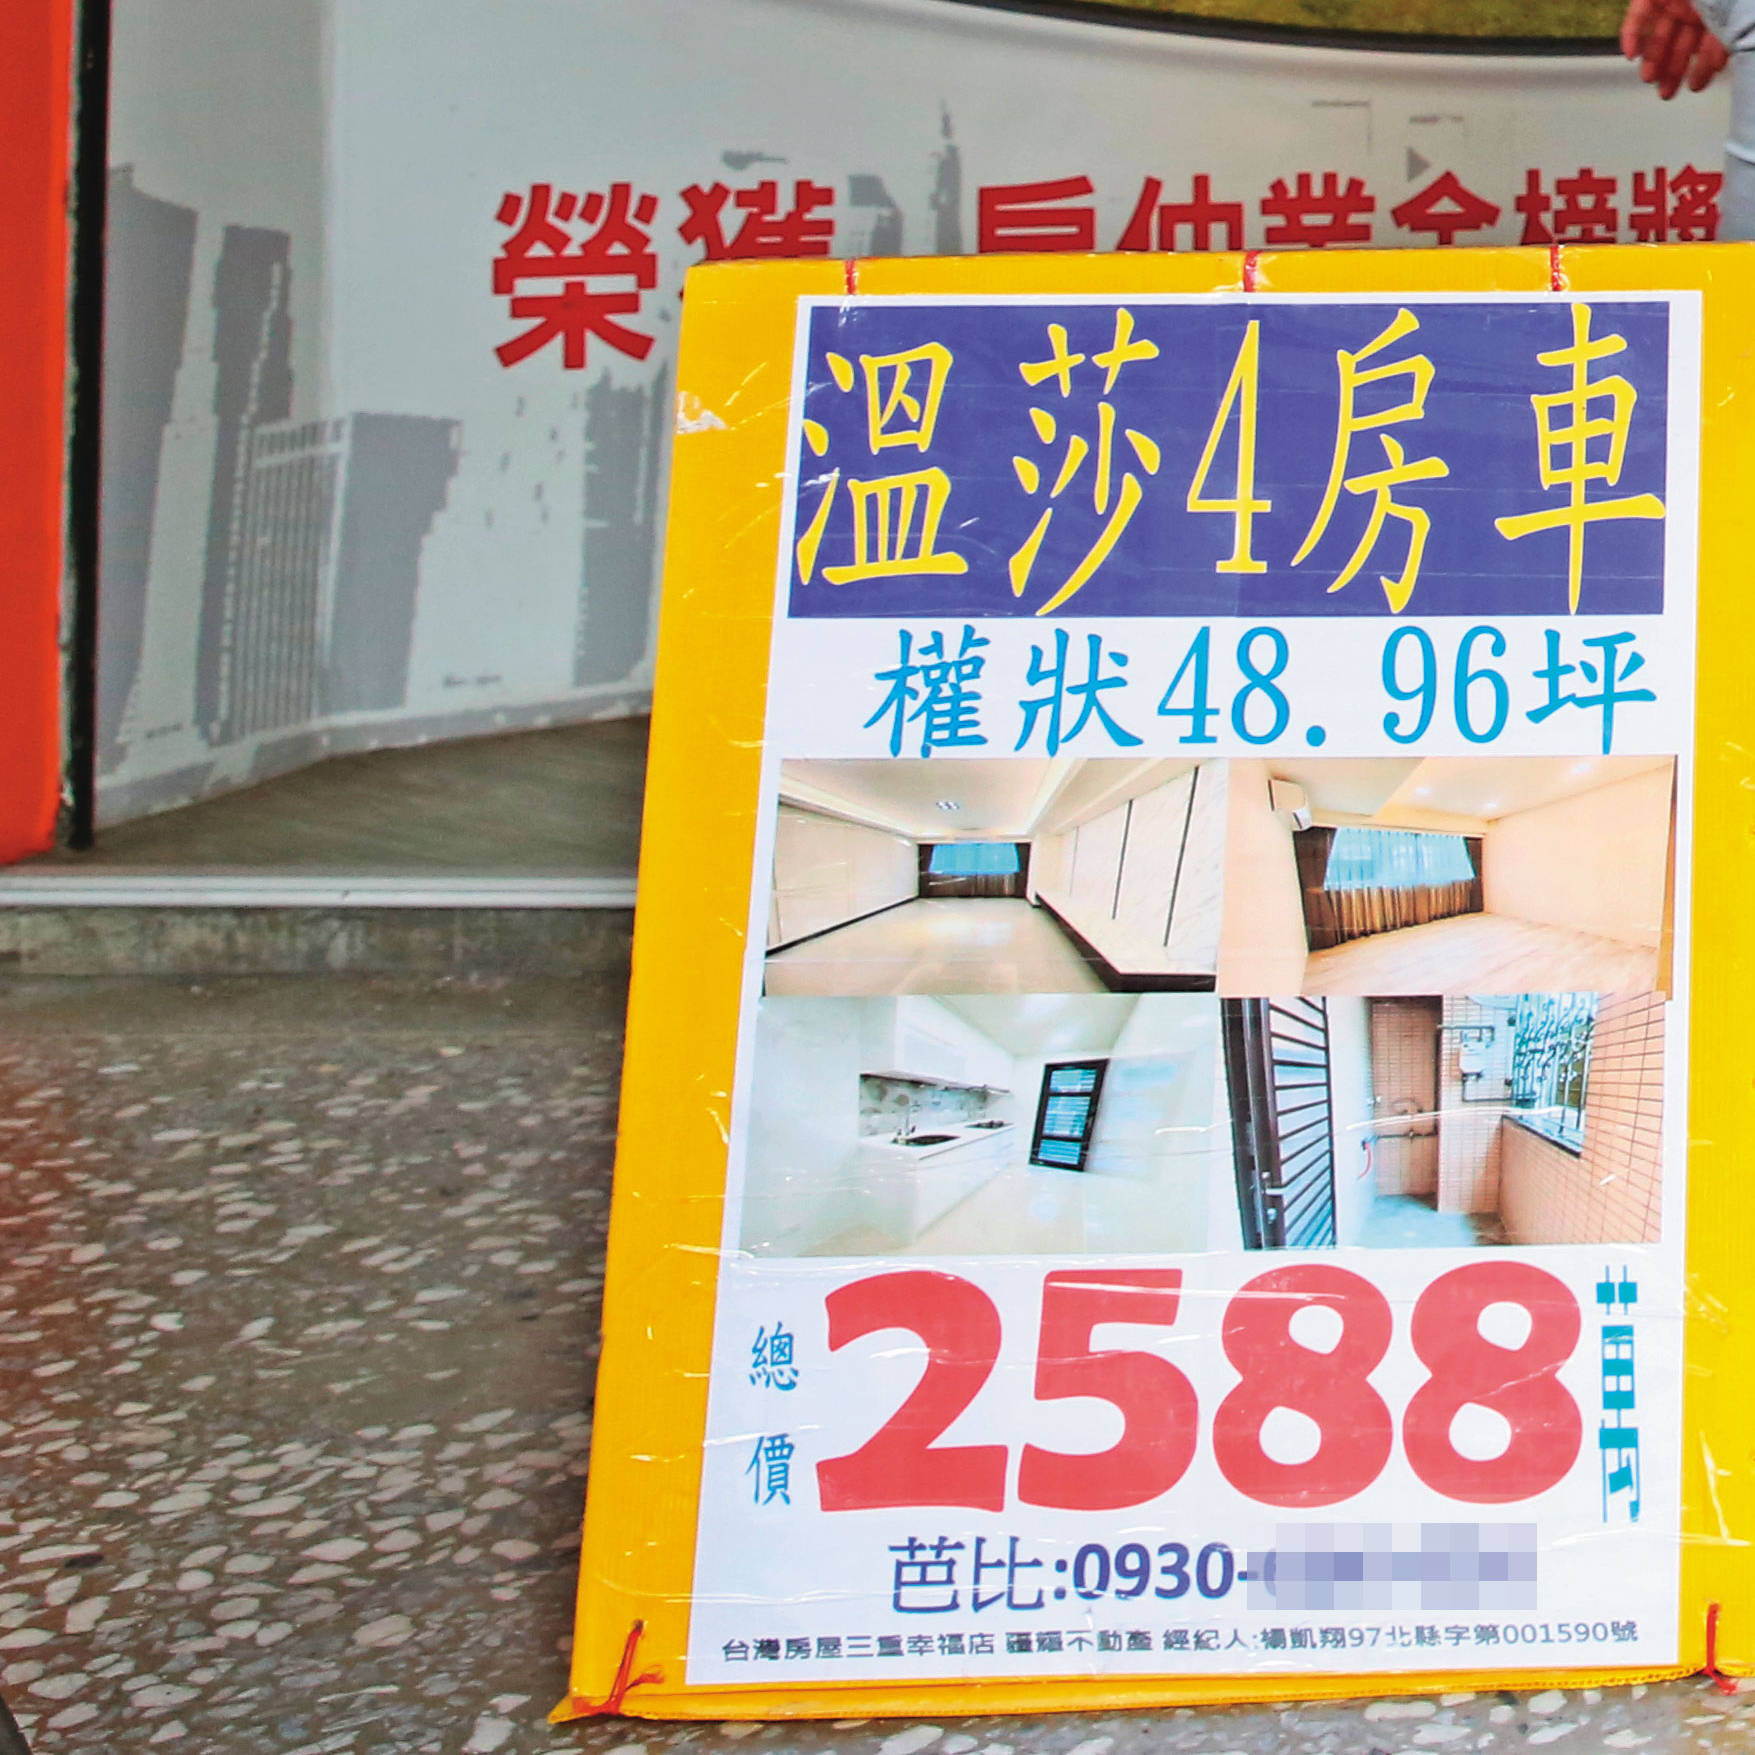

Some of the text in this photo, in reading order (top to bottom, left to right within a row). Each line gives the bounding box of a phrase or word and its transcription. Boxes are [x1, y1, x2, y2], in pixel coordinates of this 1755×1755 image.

[794, 301, 1668, 616] 溫莎4房車
[814, 1258, 1586, 1514] 2588
